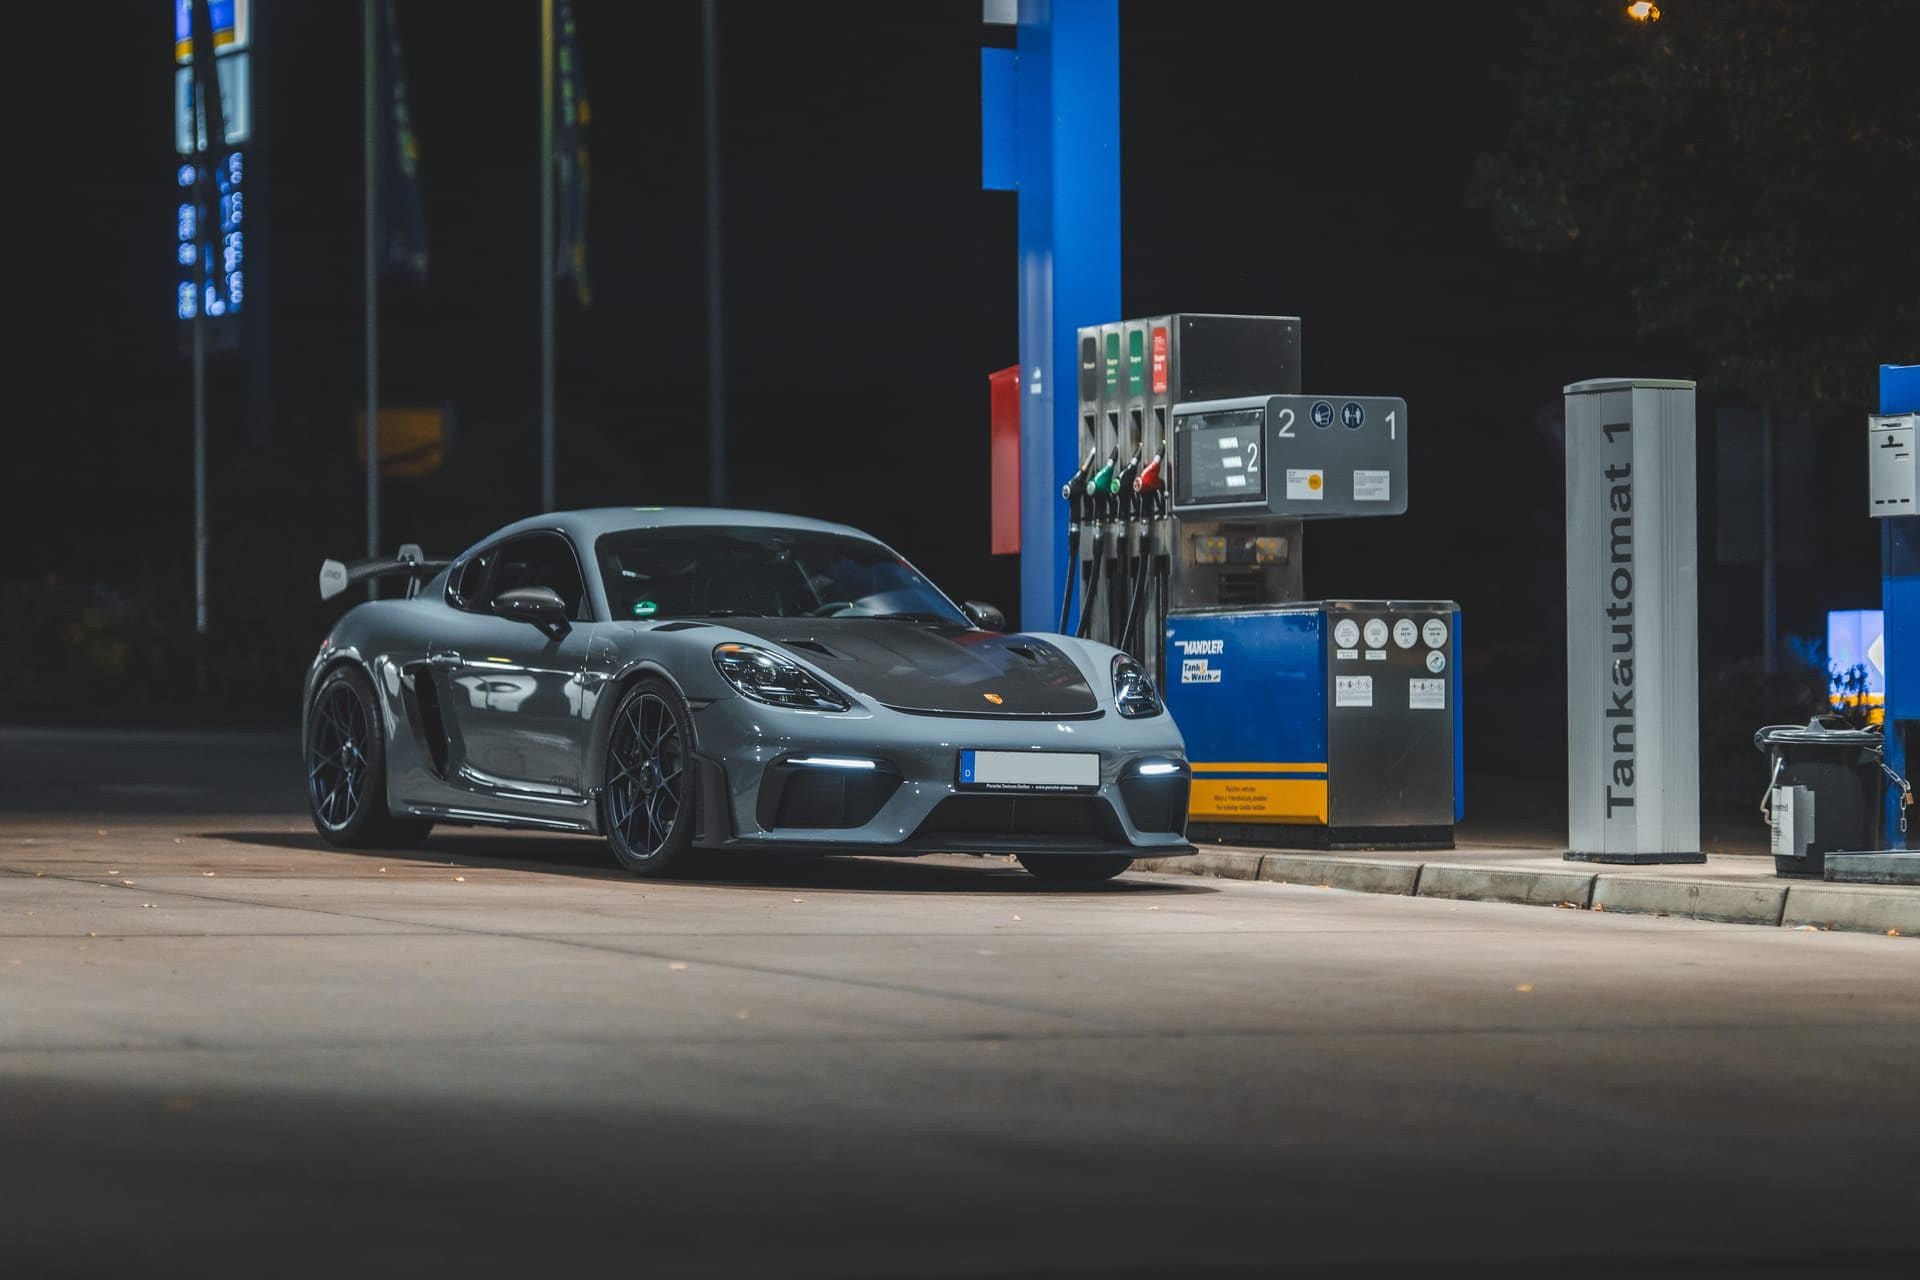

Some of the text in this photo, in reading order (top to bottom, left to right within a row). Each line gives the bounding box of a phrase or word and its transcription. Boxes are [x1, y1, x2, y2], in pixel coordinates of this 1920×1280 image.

[1278, 408, 1295, 438] 2
[1384, 410, 1396, 441] 1
[1247, 442, 1258, 473] 2
[1602, 423, 1634, 819] Tankautomat 1
[965, 769, 971, 777] D
